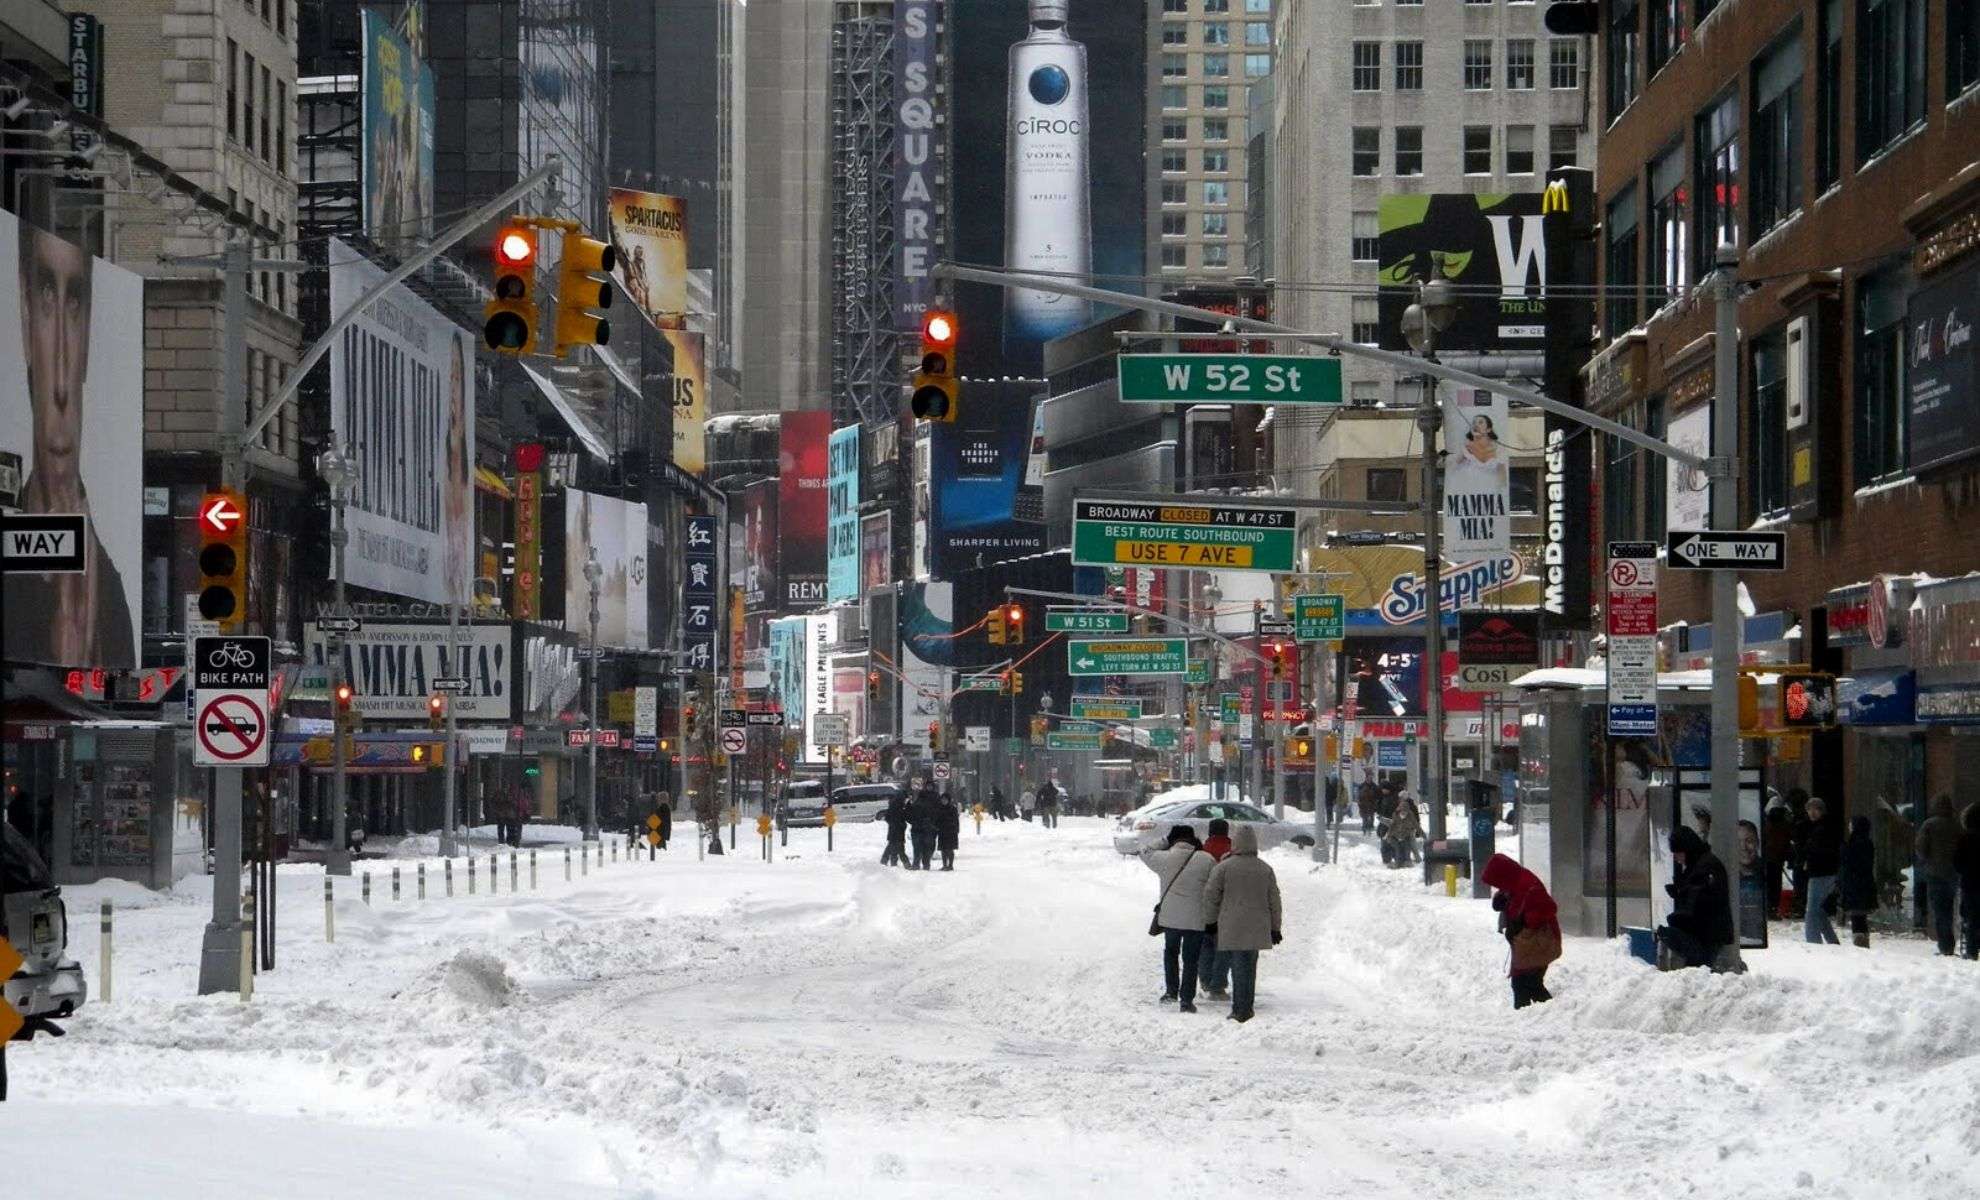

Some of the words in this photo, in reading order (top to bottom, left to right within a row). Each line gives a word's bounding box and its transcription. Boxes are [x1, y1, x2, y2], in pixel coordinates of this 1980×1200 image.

[71, 16, 88, 150] STARBUS
[900, 61, 934, 277] SQUARE
[624, 204, 682, 232] SPARTACUS
[903, 302, 927, 313] NYC
[1501, 301, 1524, 313] THE
[1164, 364, 1191, 392] W
[1206, 364, 1251, 392] 52
[1264, 364, 1302, 393] St
[1088, 505, 1155, 521] BROADWAY
[1162, 508, 1209, 522] CLOSED
[1215, 511, 1231, 522] AT
[1235, 512, 1246, 523] W
[1249, 512, 1265, 524] 47
[1268, 513, 1283, 525] ST
[1447, 493, 1505, 517] MAMMA
[1105, 525, 1137, 538] BEST
[1139, 527, 1178, 540] ROUTE
[1183, 528, 1265, 543] SOUTHBOUND
[1460, 517, 1495, 541] MIA!
[14, 533, 65, 554] WAY
[949, 539, 1000, 547] SHARPER
[1003, 538, 1041, 548] LIVING
[1685, 542, 1719, 558] ONE
[1734, 543, 1770, 559] WAY
[1131, 543, 1167, 561] USE
[1179, 545, 1189, 561] 7
[1200, 546, 1237, 564] AVE
[1063, 617, 1076, 628] W
[1079, 617, 1093, 628] 51
[1097, 617, 1111, 628] St
[1152, 652, 1180, 660] TRAFFIC
[200, 672, 229, 684] BIKE
[233, 672, 264, 684] PATH
[818, 673, 827, 706] EAGLE
